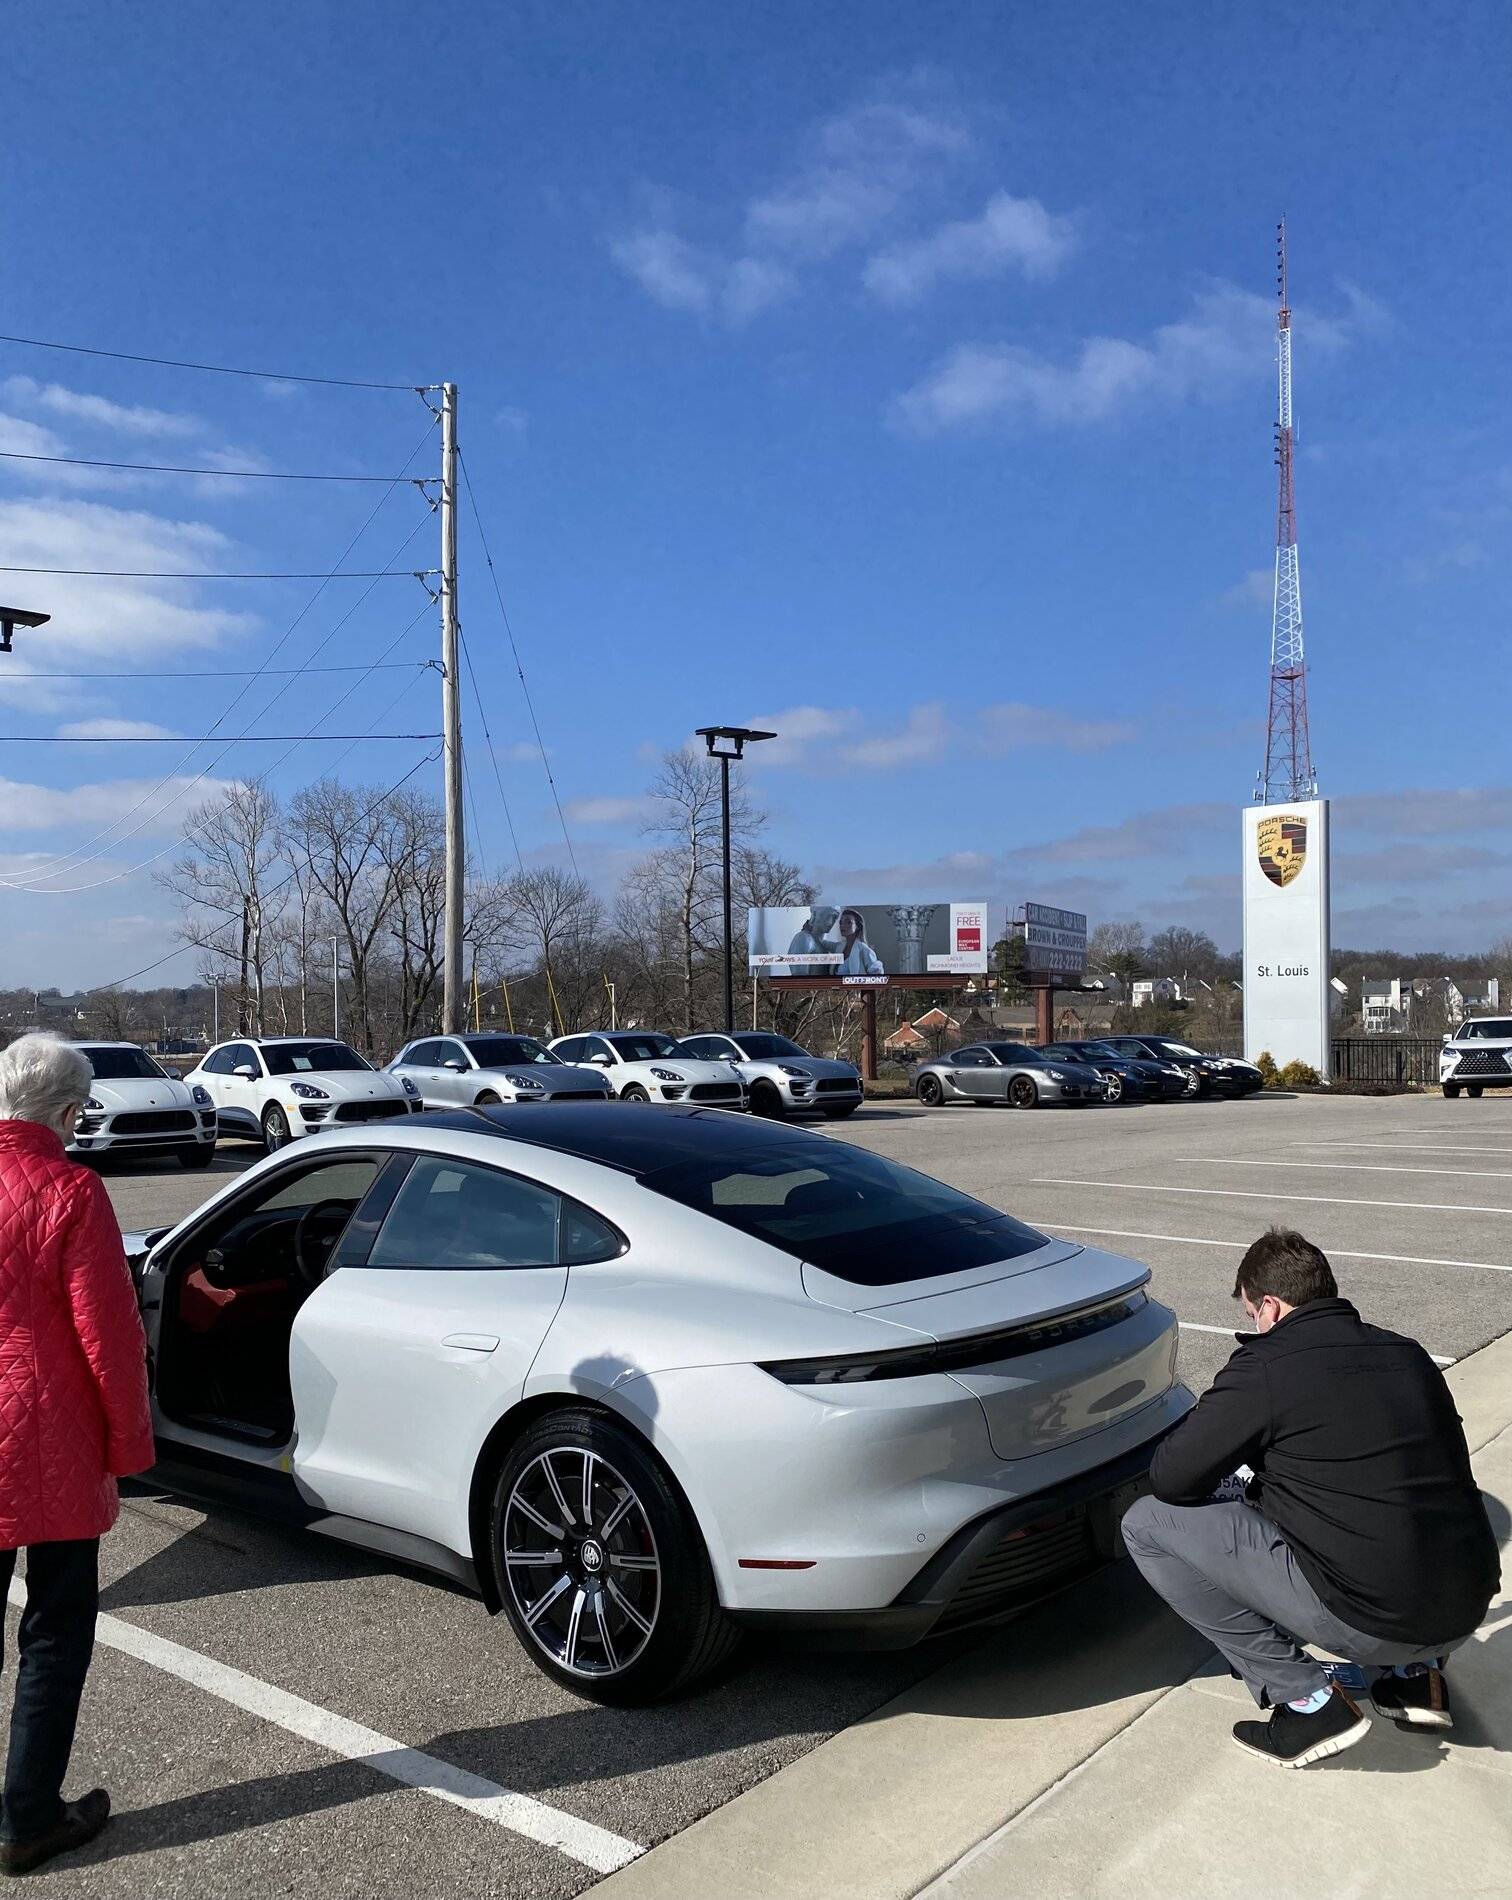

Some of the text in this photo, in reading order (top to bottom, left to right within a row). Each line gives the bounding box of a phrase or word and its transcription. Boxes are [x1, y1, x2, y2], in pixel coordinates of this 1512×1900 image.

[1258, 816, 1306, 827] PORSCHE
[957, 916, 981, 926] FREE
[1028, 927, 1051, 943] BROWN
[1257, 964, 1309, 977] St. Louis
[844, 976, 887, 984] OUTFRONT
